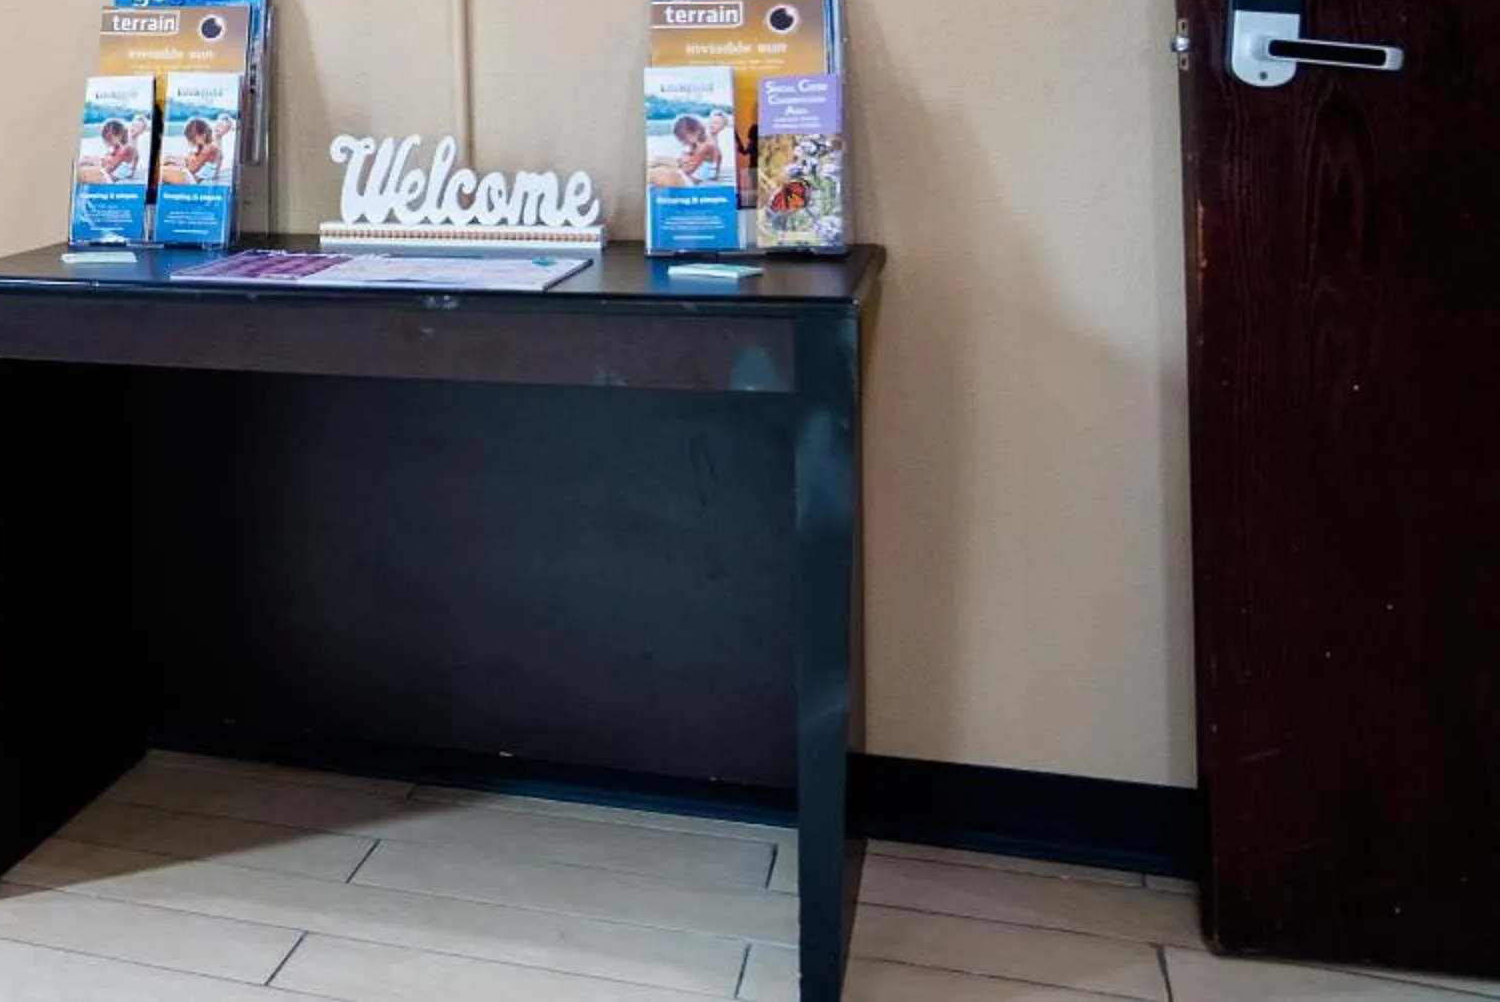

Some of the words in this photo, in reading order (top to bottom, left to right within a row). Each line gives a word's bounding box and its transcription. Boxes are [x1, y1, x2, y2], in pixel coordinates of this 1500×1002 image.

[112, 14, 176, 32] terrain
[665, 5, 738, 24] terrain
[330, 134, 599, 226] Welcome
